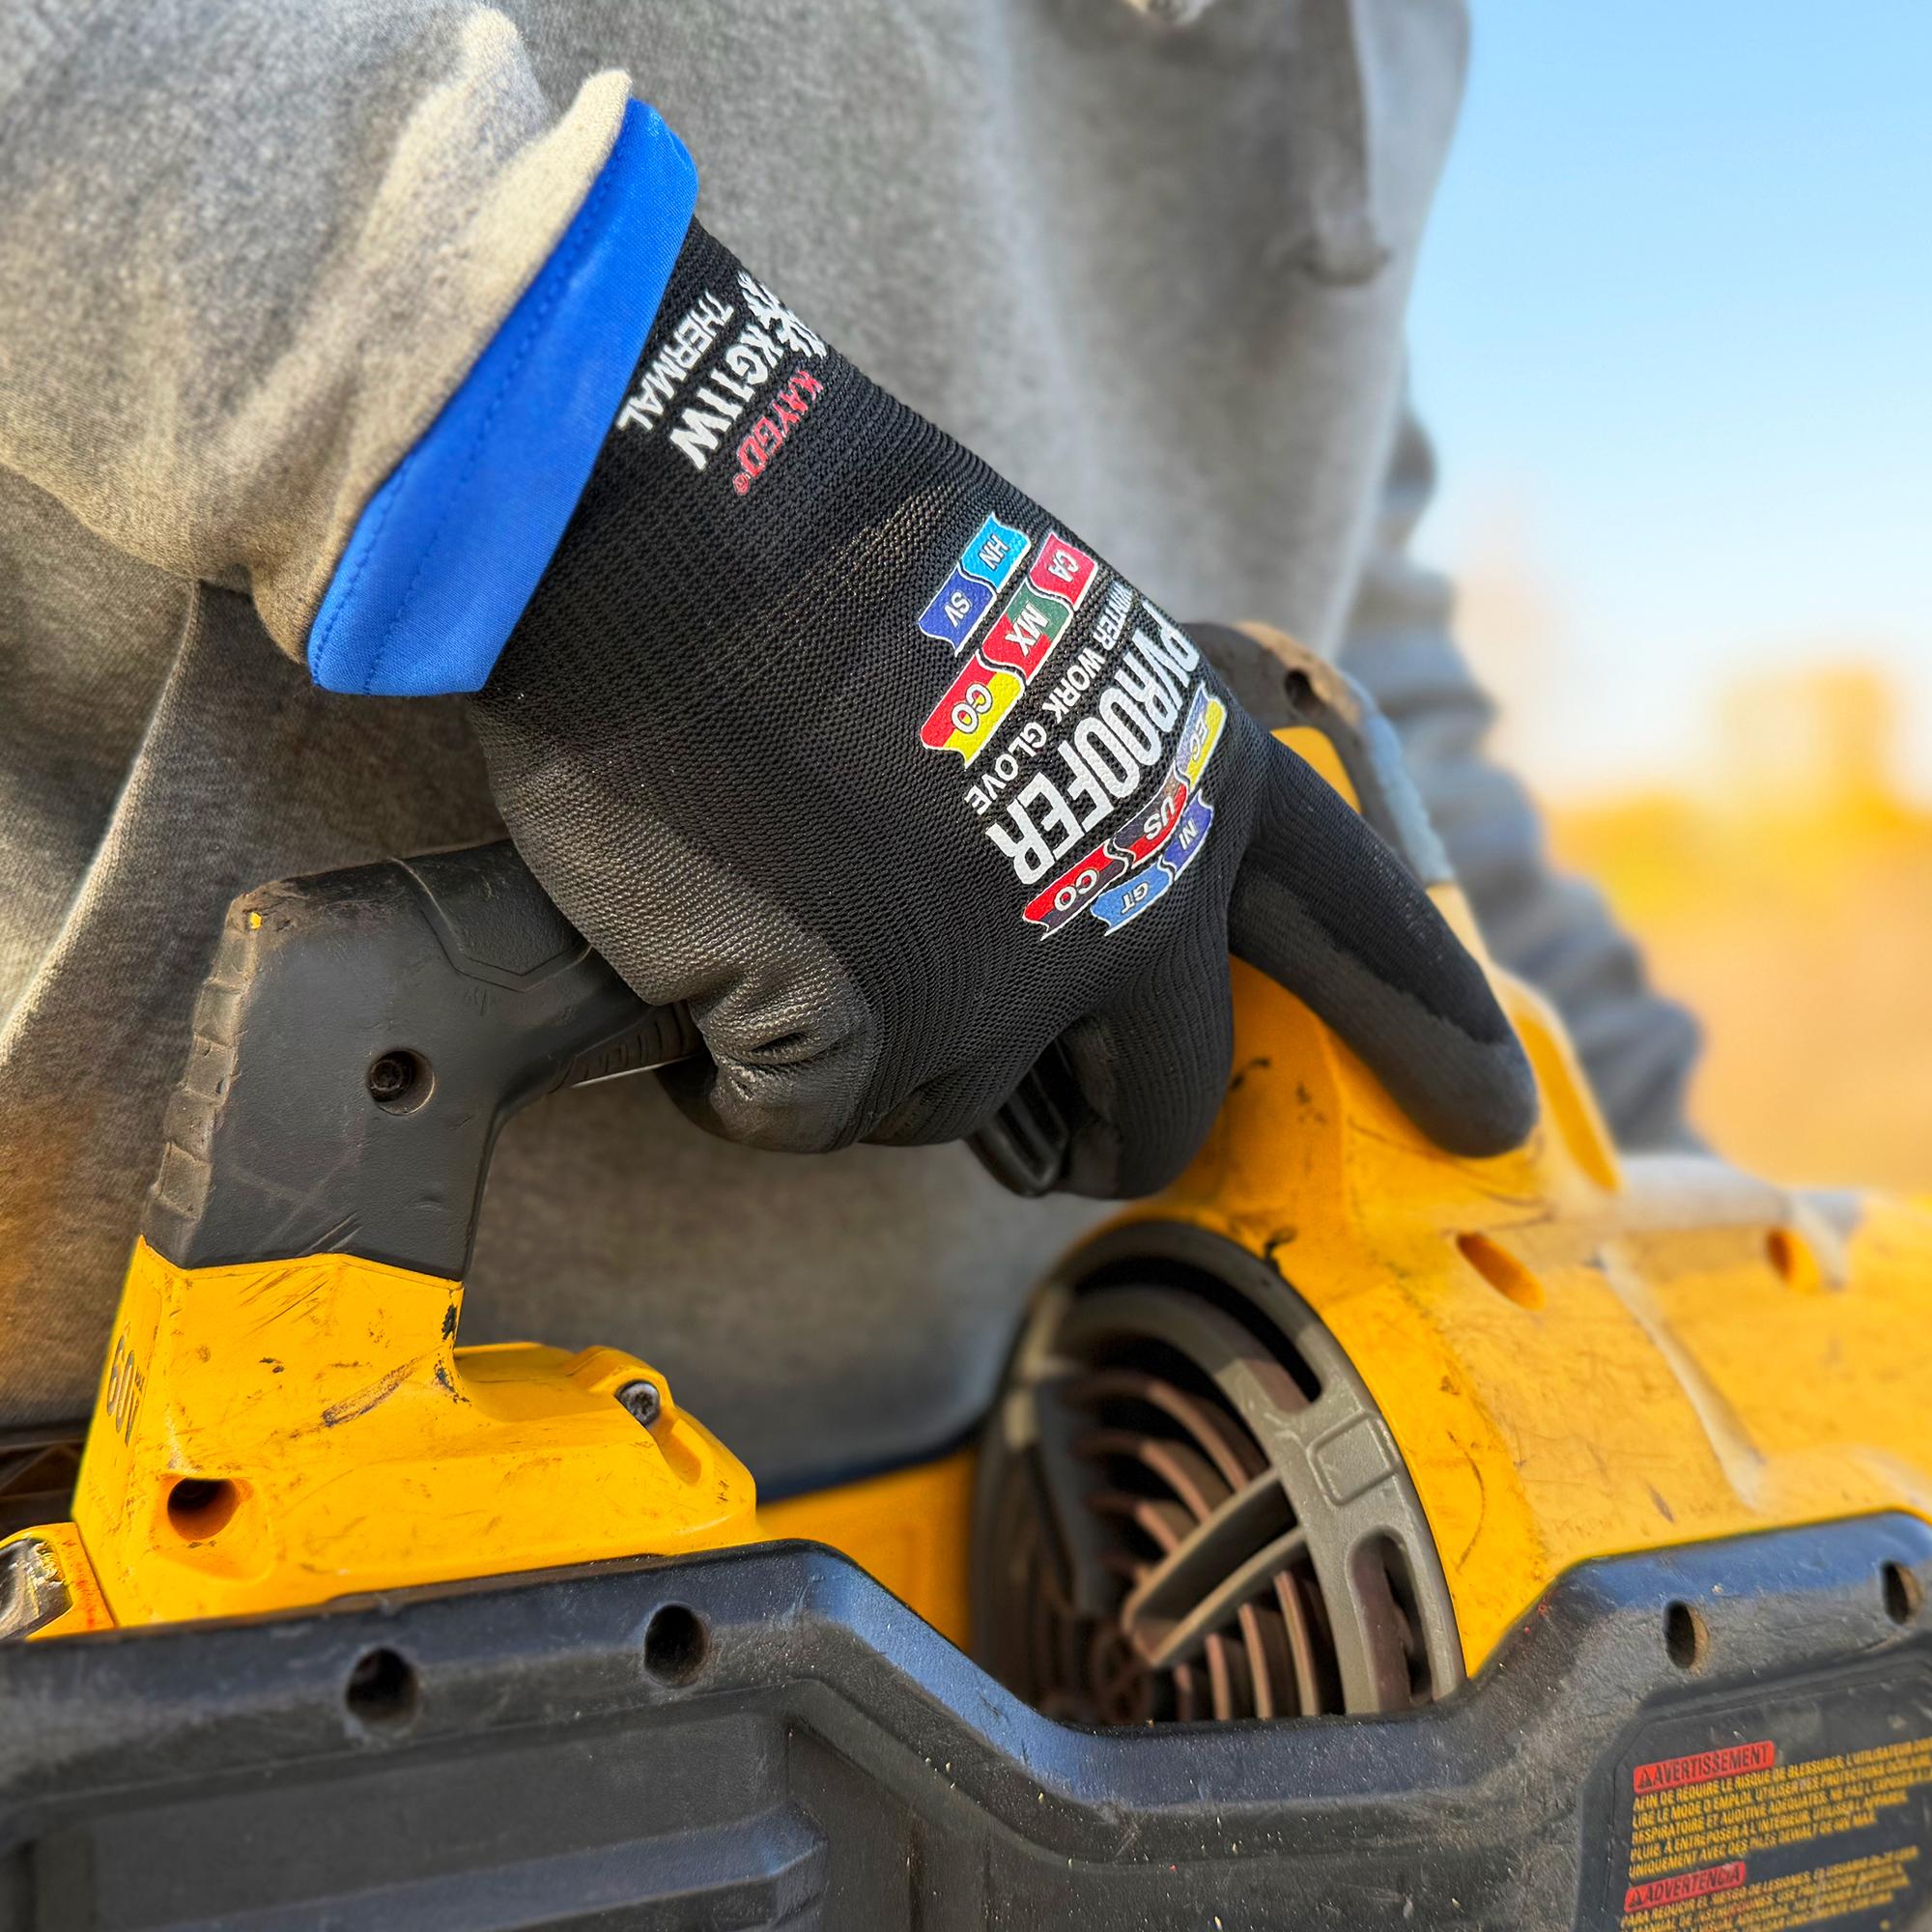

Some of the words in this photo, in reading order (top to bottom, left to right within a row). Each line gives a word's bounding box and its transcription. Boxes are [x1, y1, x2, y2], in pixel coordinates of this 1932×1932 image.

[617, 291, 734, 431] THERMAL
[669, 324, 784, 471] KG11W
[979, 533, 1009, 570] HN
[1045, 548, 1079, 582] CA
[945, 590, 973, 628] SV
[1005, 601, 1051, 658] MX
[1094, 580, 1131, 657] WINTER
[952, 684, 992, 733] CO
[1040, 651, 1107, 726] WORK
[983, 598, 1201, 886] PVROOFER
[962, 724, 1050, 817] GLOVE
[1146, 795, 1177, 840] US
[1179, 813, 1200, 850] NI
[1056, 867, 1098, 913] CO
[1122, 880, 1150, 916] GT
[1653, 1743, 1770, 1786] AVERTISSEMENT
[1647, 1864, 1740, 1902] ADVERTENCIA
